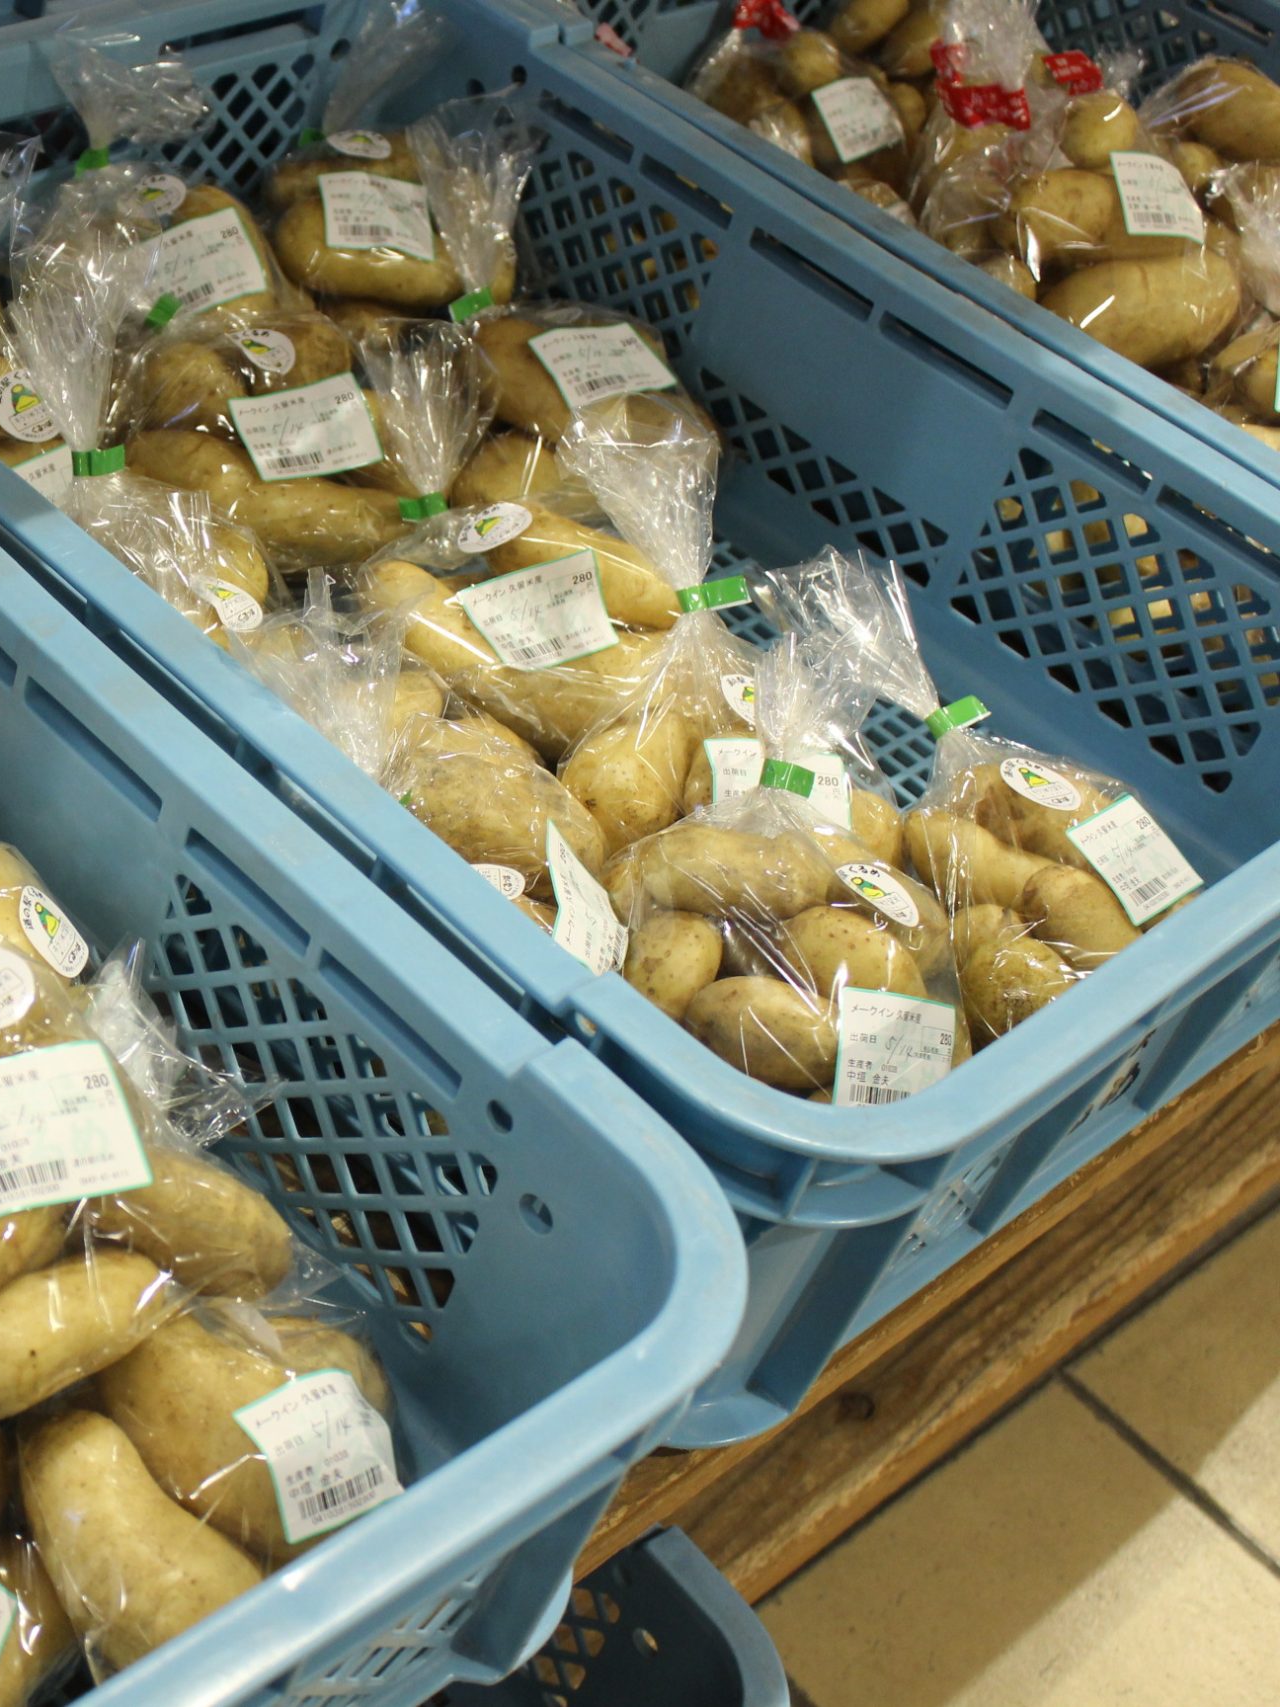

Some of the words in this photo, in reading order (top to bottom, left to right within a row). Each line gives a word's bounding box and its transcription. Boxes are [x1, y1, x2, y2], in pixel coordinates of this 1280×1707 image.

[221, 226, 239, 239] 280
[334, 392, 354, 405] 280
[572, 570, 593, 586] 280
[472, 588, 506, 608] メークイン
[508, 574, 543, 594] 久留米産
[719, 748, 758, 759] メークイン
[817, 775, 840, 787] 280
[1135, 815, 1153, 831] 280
[850, 1004, 895, 1018] メークイン
[896, 1009, 922, 1025] 久留米産
[849, 1032, 878, 1045] 出荷日
[884, 1033, 914, 1066] 5/14
[847, 1058, 873, 1071] 生産者
[82, 1072, 110, 1091] 280
[846, 1070, 867, 1084] 中垣
[871, 1072, 890, 1087] 金夫
[255, 1401, 299, 1429] メークイン
[311, 1409, 353, 1450] 5/14
